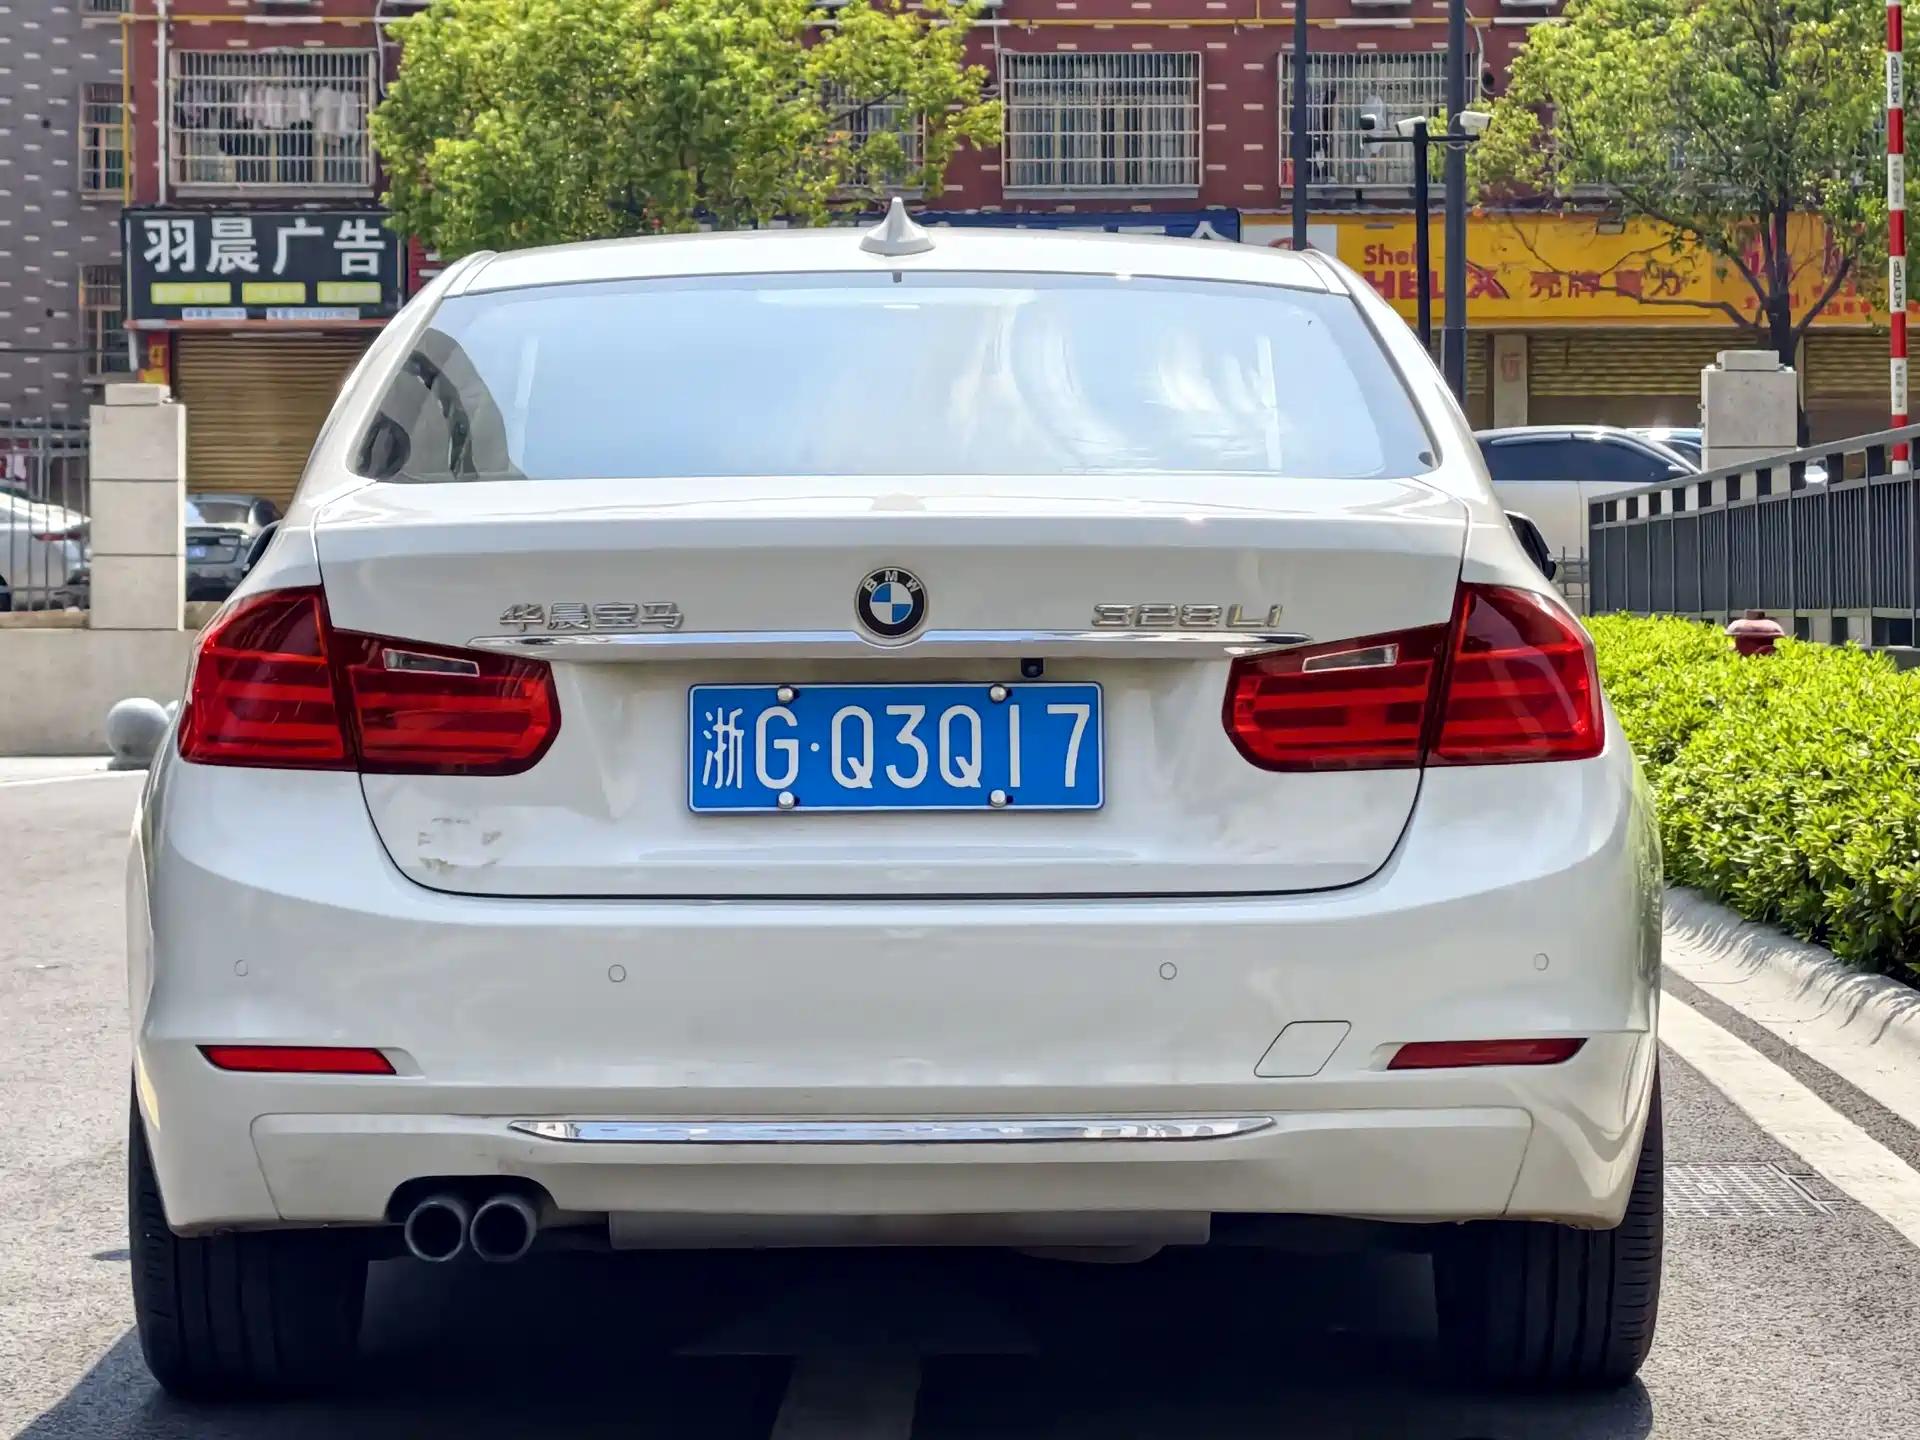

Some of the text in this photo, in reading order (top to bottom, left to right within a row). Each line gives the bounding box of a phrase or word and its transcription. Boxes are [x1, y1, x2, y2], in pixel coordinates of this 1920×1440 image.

[143, 217, 386, 276] 羽晨广告
[1364, 243, 1418, 266] Shel
[1362, 270, 1506, 299] HELX
[863, 570, 921, 593] BMW
[499, 602, 684, 632] 华晨宝马
